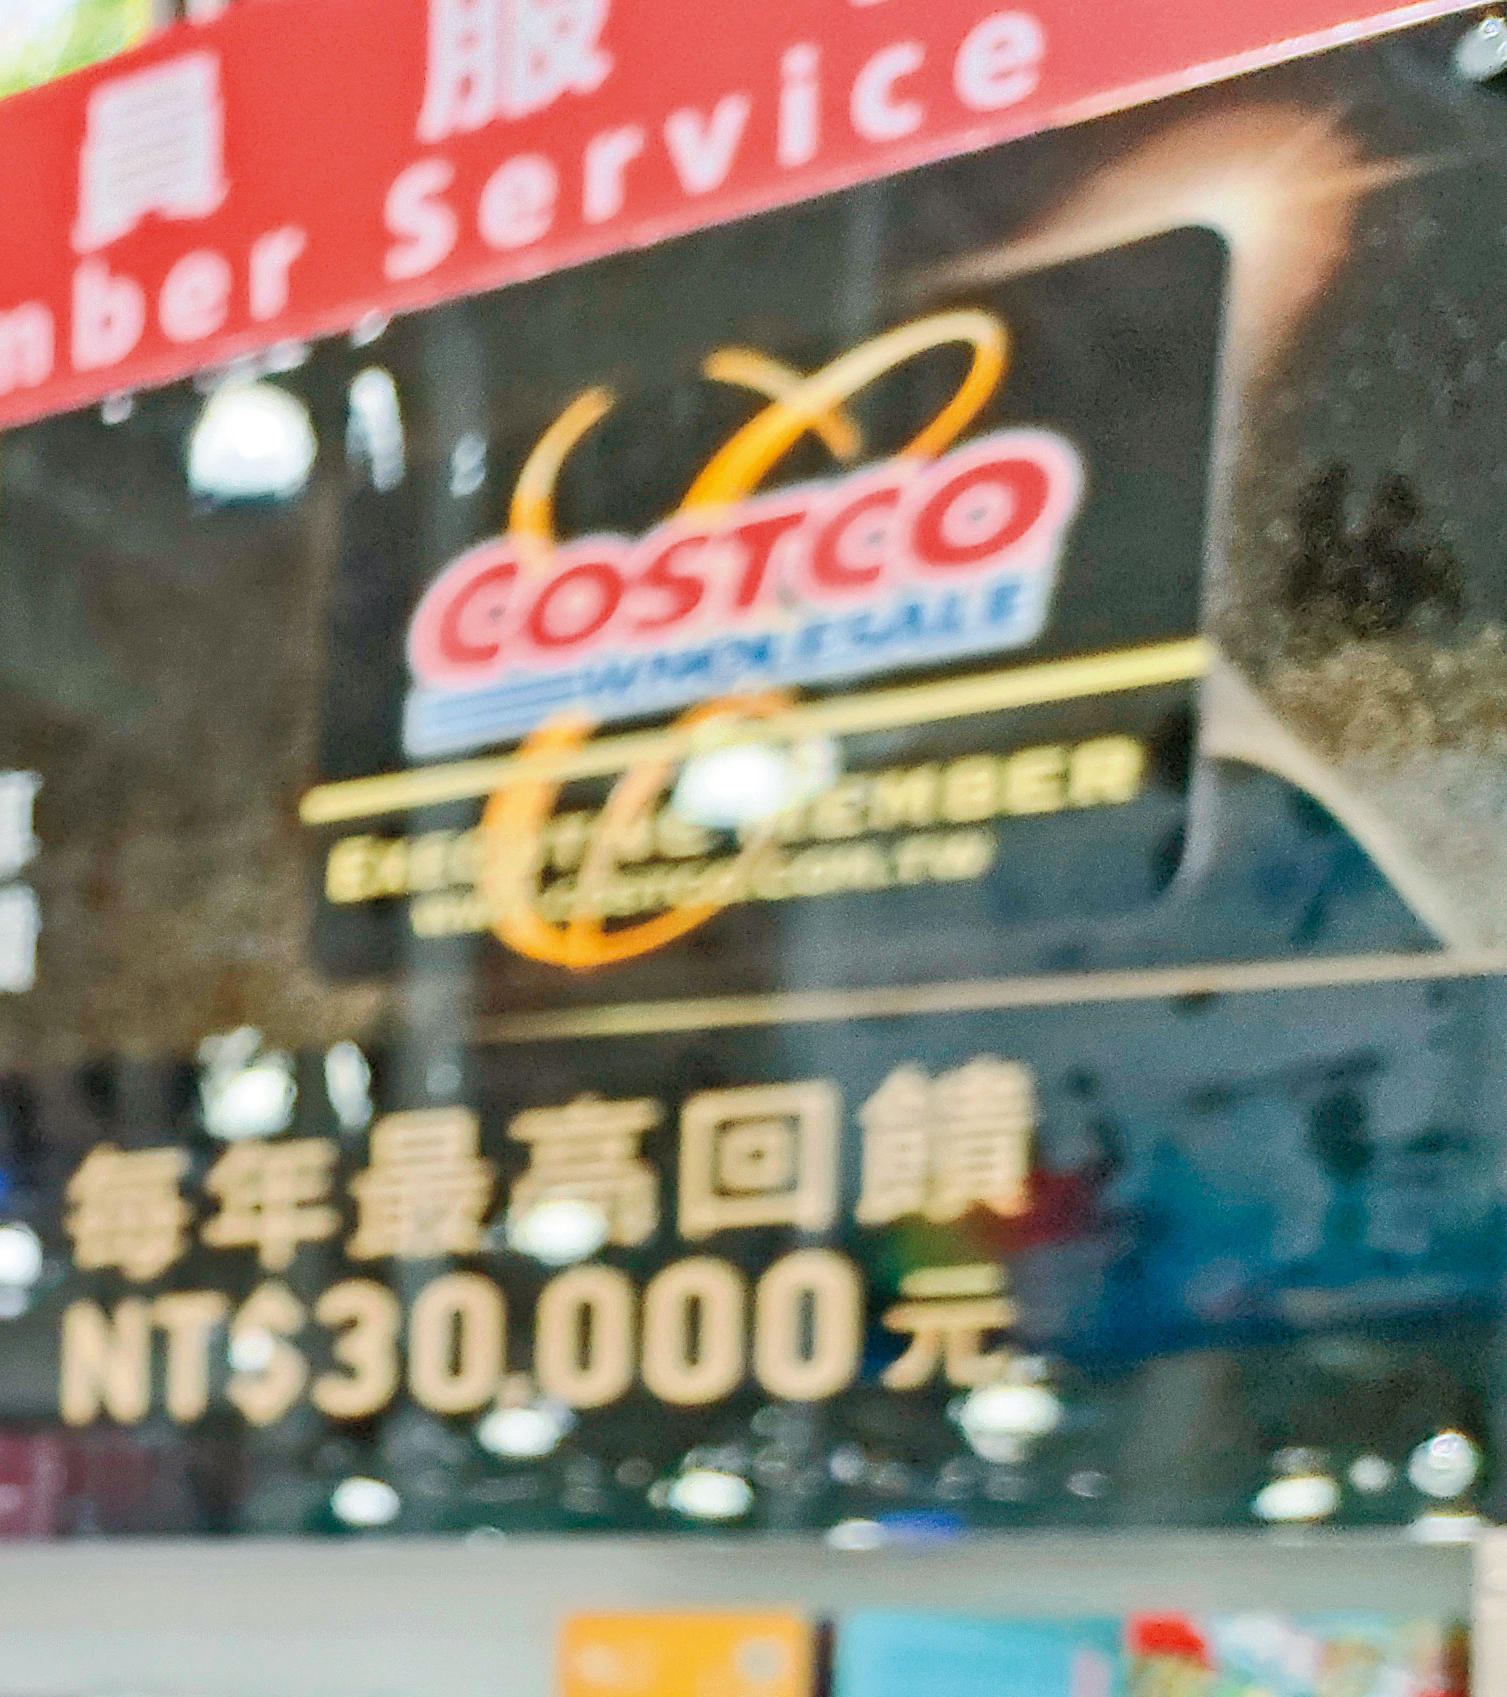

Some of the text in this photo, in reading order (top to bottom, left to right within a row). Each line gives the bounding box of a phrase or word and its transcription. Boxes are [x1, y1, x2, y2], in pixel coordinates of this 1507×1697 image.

[384, 11, 1048, 282] Service
[433, 455, 1053, 668] COSTCO
[729, 733, 1145, 852] EMBER
[63, 1054, 1039, 1281] 每年最高回饋
